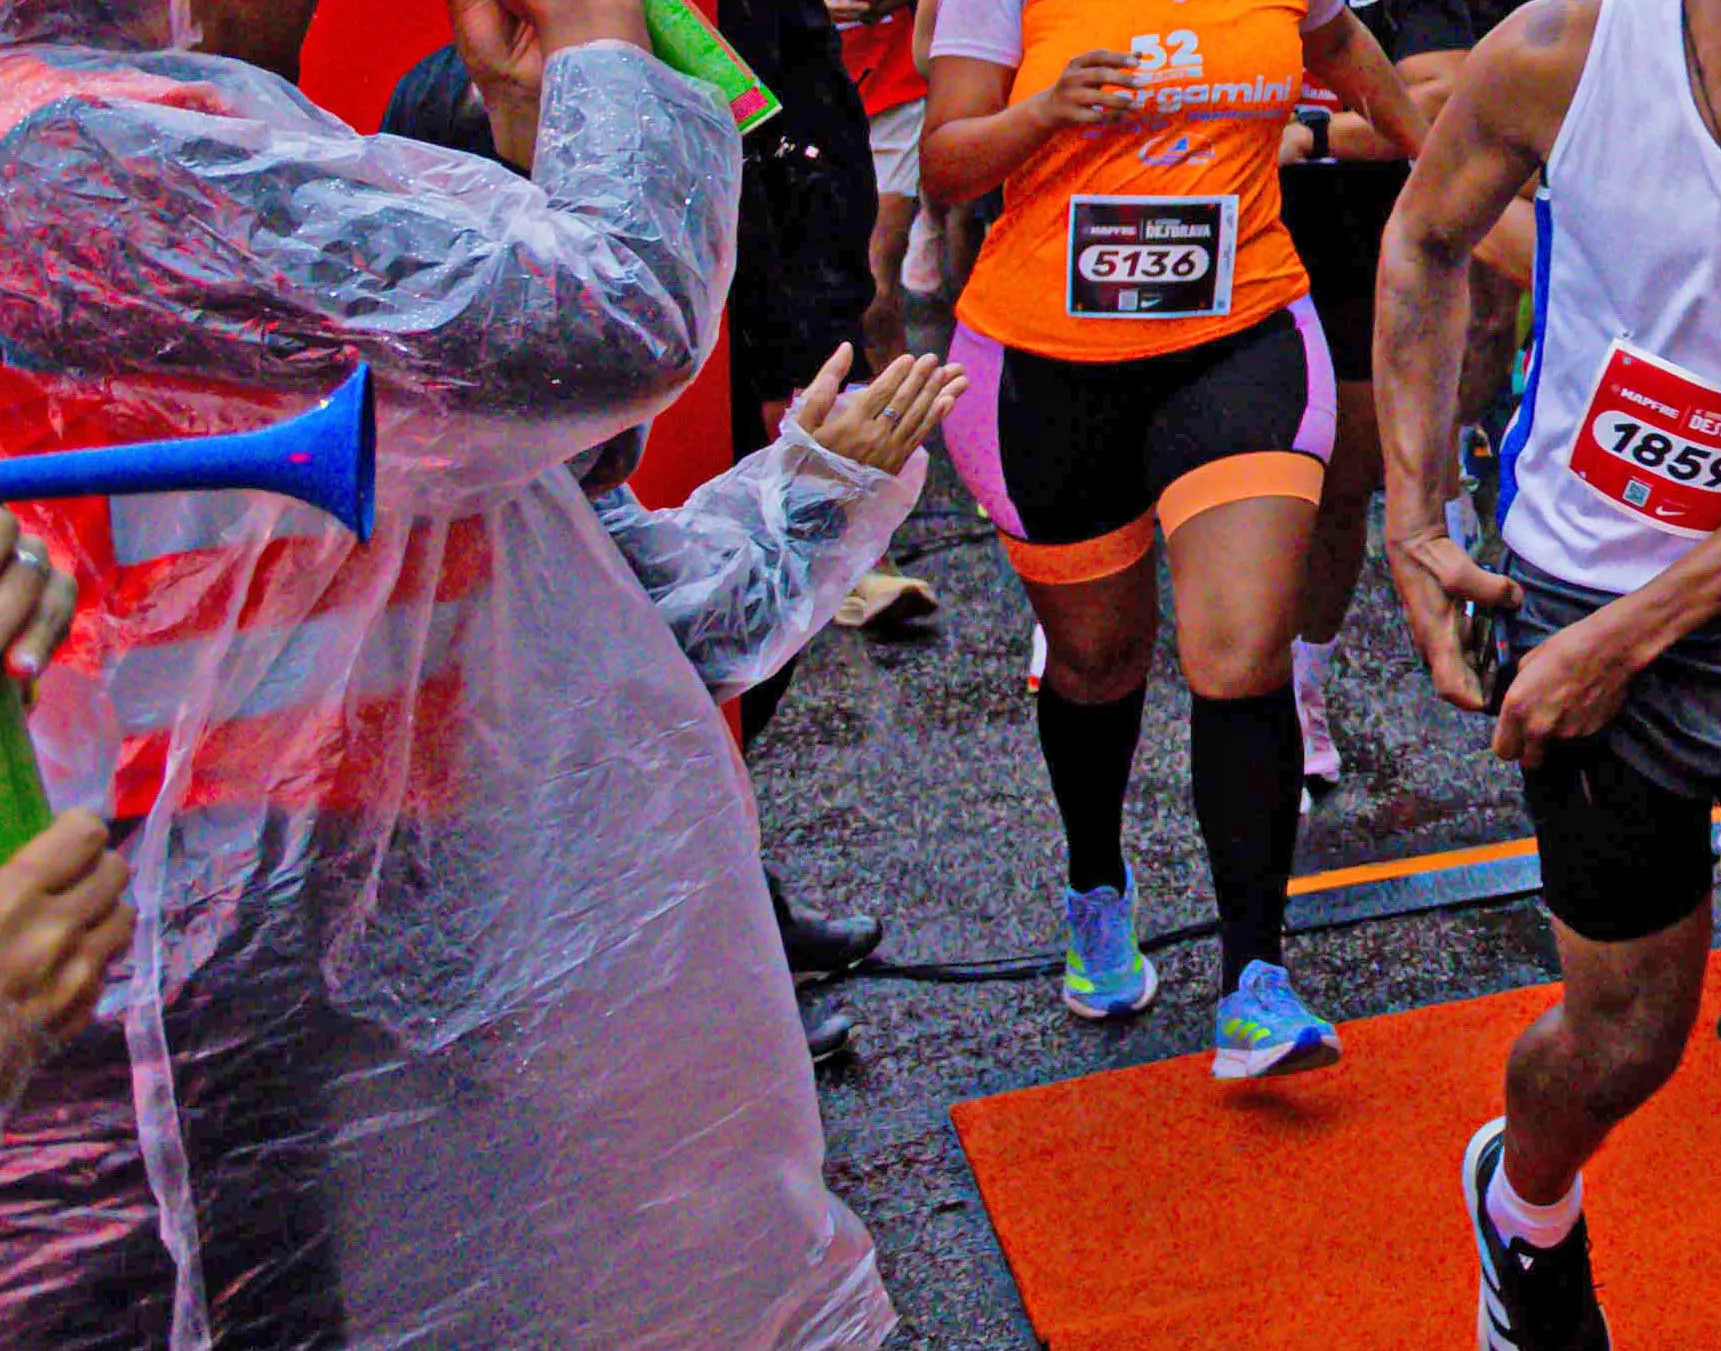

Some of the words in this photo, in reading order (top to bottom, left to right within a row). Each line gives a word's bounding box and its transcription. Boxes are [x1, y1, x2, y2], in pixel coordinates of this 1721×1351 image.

[1131, 29, 1203, 71] 52
[1091, 249, 1197, 278] 5136
[1619, 387, 1680, 420] MAPFRE
